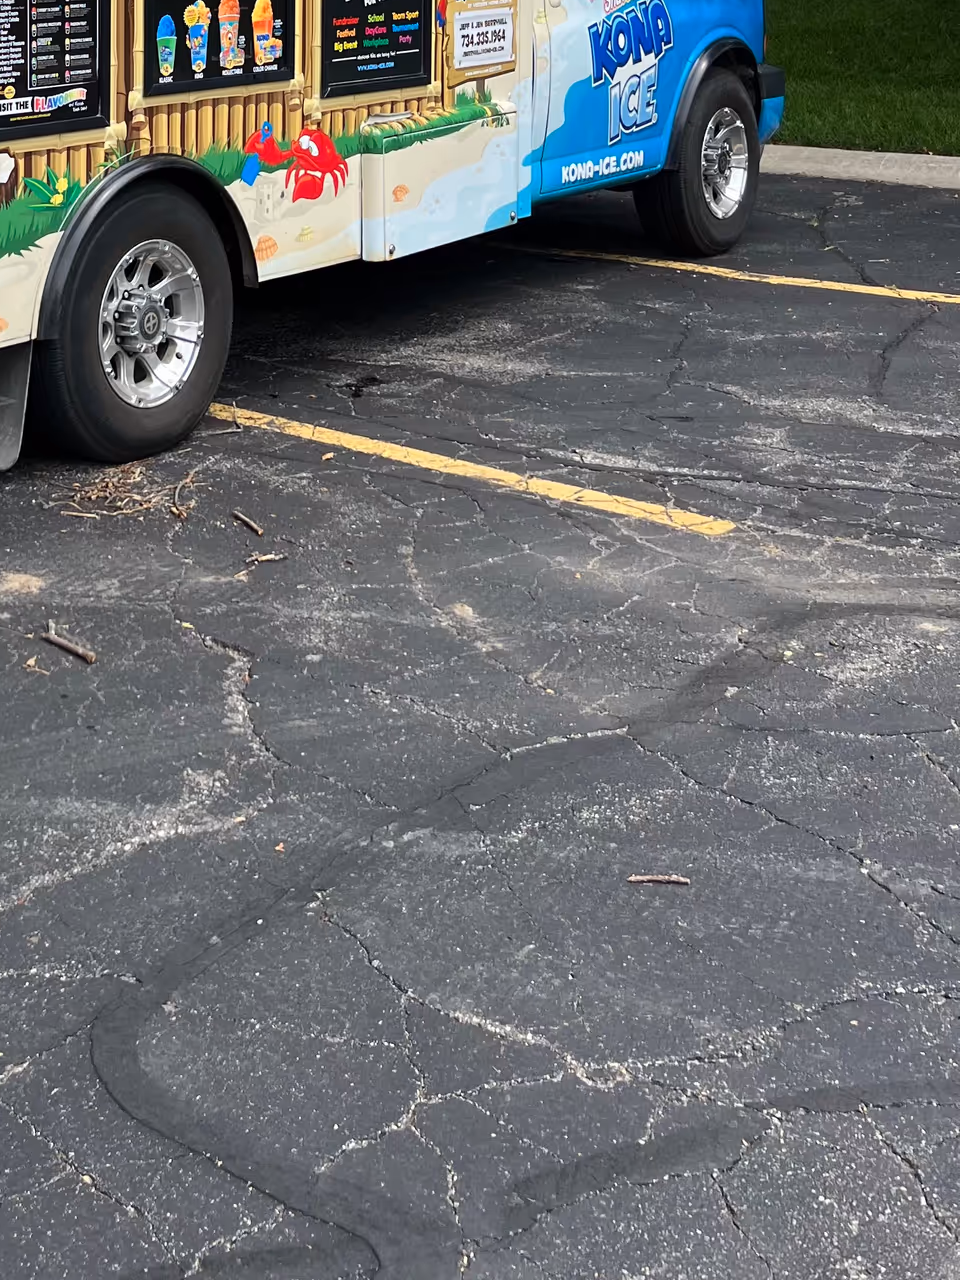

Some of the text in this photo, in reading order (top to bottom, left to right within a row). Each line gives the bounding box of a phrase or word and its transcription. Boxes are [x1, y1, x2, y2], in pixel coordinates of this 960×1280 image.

[368, 13, 384, 23] School
[392, 10, 419, 20] Team Sport
[333, 17, 359, 26] Fundraiser
[460, 22, 470, 31] JEFF
[475, 21, 484, 29] JEN
[365, 26, 387, 36] DayCare
[392, 22, 419, 32] Tournament
[337, 28, 356, 38] Festival
[363, 38, 389, 48] Workplace
[399, 35, 412, 44] Party
[461, 29, 506, 48] 734.335.1964
[334, 40, 358, 52] Big Event
[15, 100, 29, 111] THE
[608, 63, 658, 145] ICE
[561, 150, 644, 184] KONA-ICE.COM
